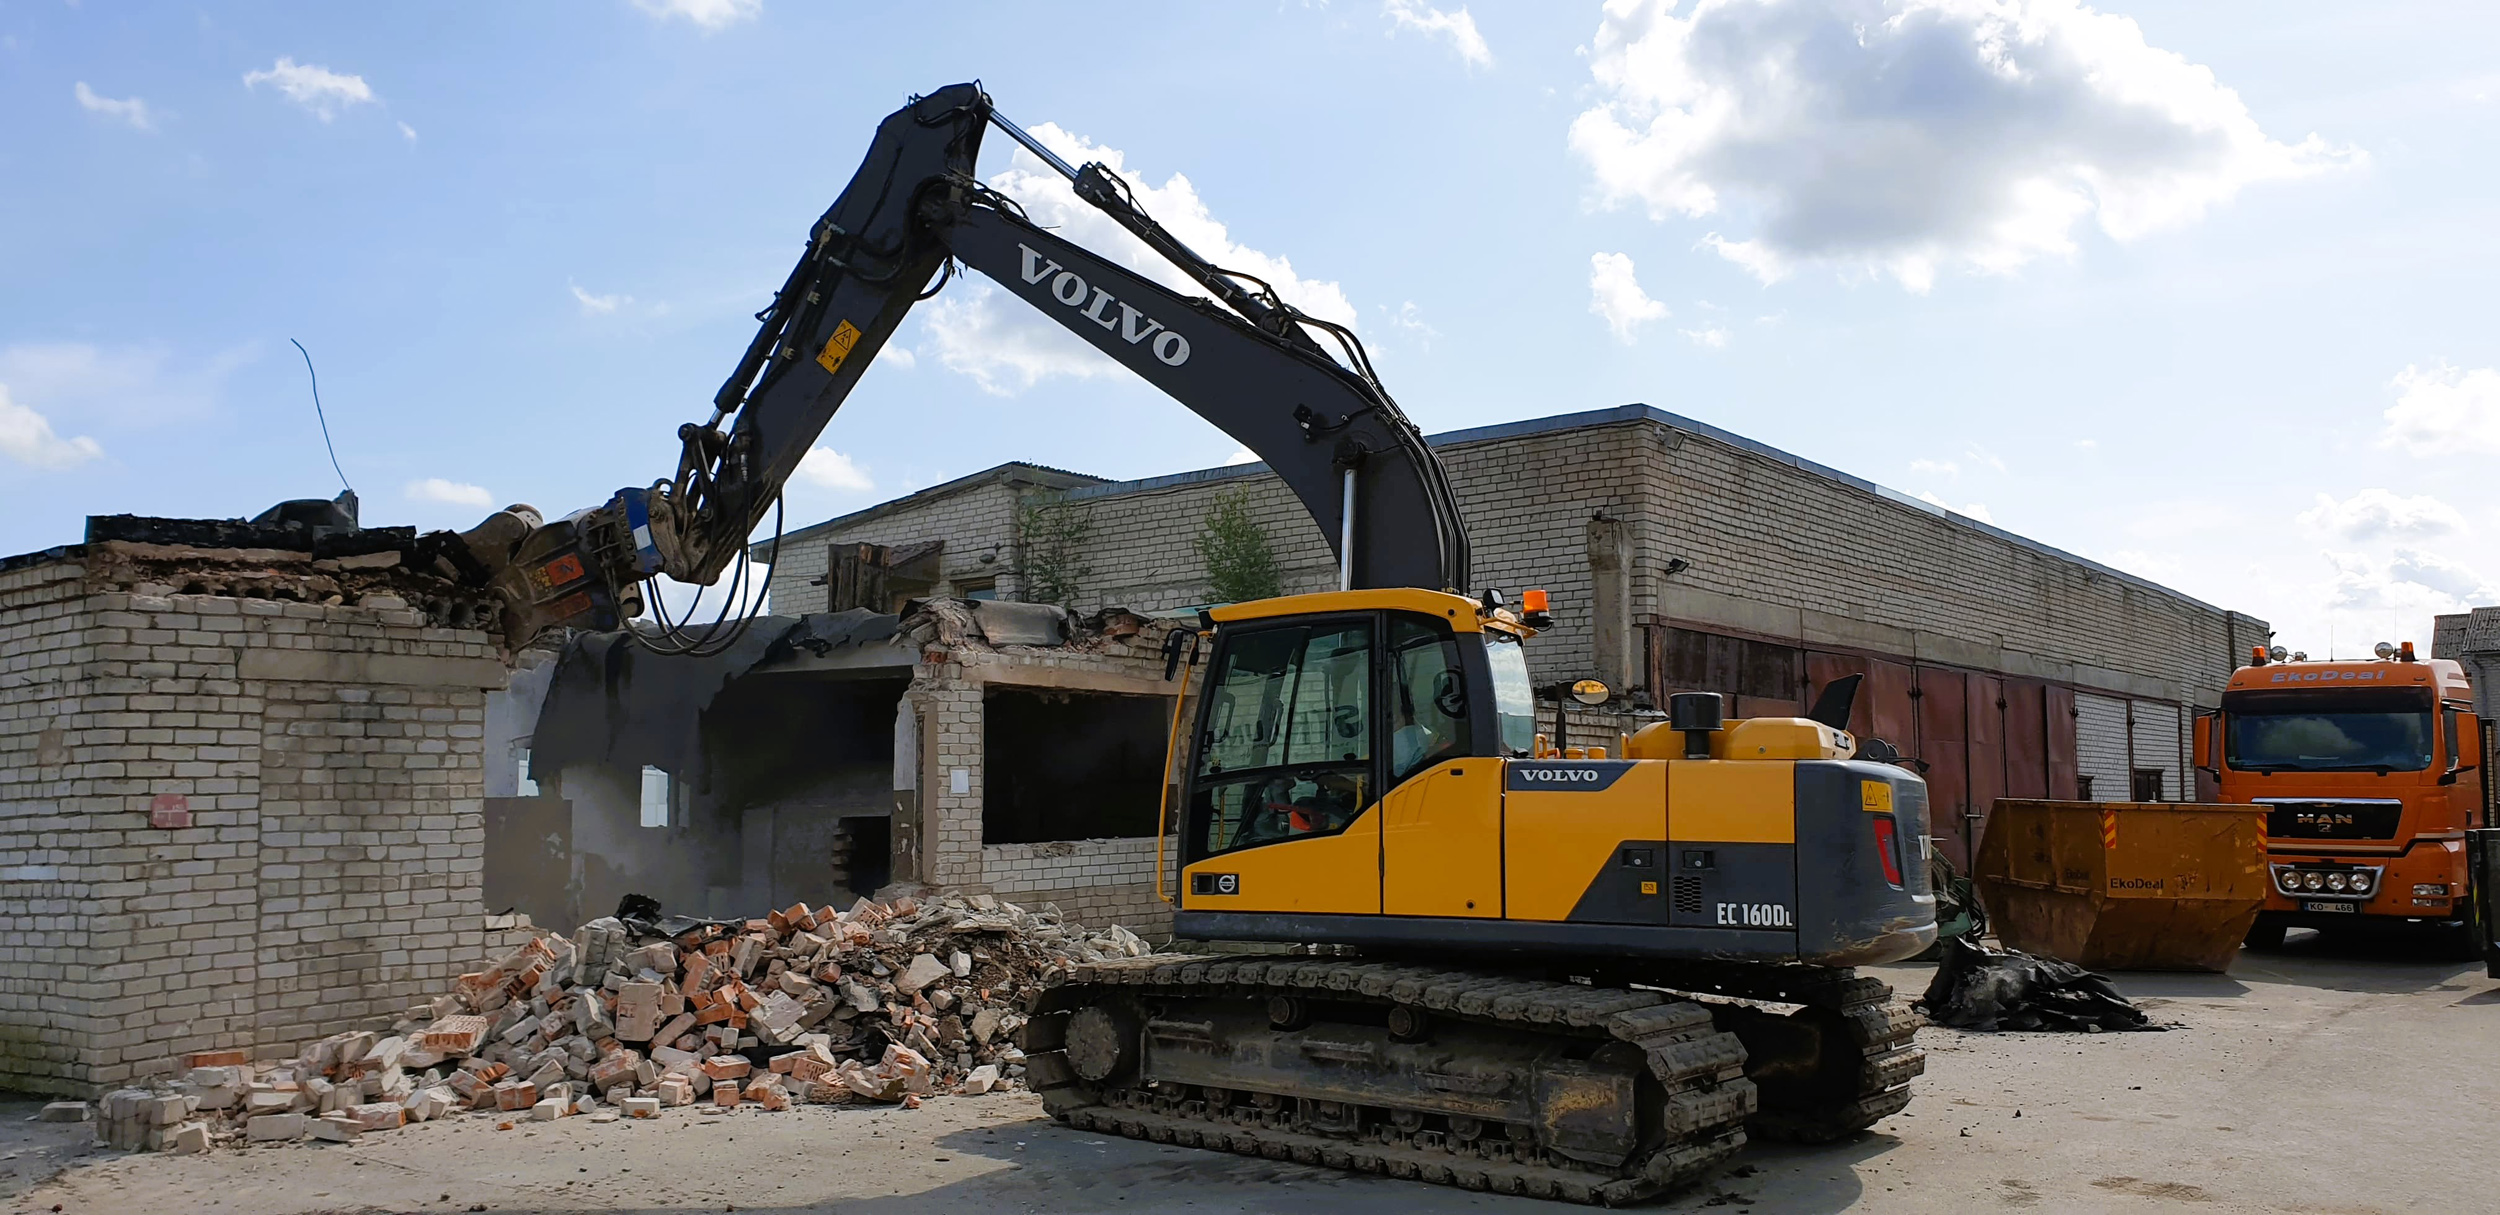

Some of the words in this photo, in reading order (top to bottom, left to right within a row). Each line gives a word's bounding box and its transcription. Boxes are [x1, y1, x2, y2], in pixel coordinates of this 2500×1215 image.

[1017, 242, 1191, 367] VOLVO
[2271, 670, 2385, 682] EkoDeal
[1519, 769, 1599, 782] VOLVO
[2297, 813, 2353, 824] MAN
[2110, 877, 2164, 890] EkoDeal
[1716, 902, 1738, 925] EC
